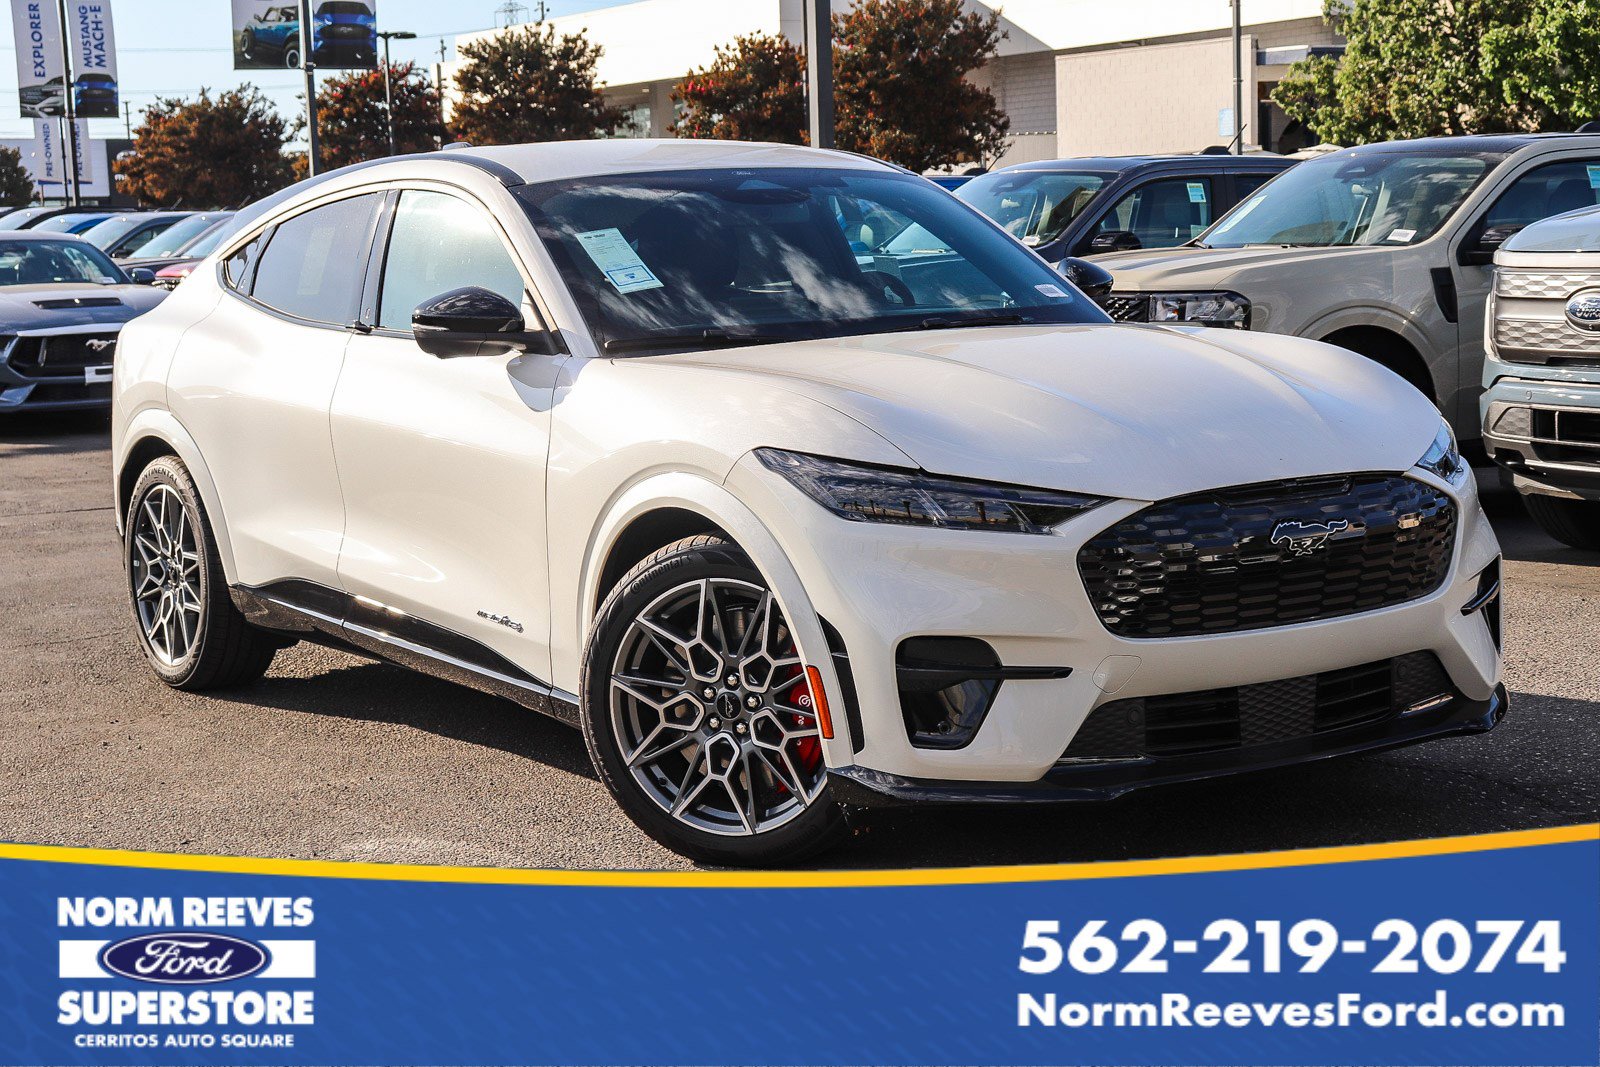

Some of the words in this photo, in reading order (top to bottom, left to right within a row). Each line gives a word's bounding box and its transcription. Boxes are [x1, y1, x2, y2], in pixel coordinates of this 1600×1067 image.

[28, 3, 46, 78] EXPLORER
[78, 5, 93, 68] MUSTANG
[90, 5, 107, 68] MACH-E
[43, 123, 53, 177] PRE-OWNED
